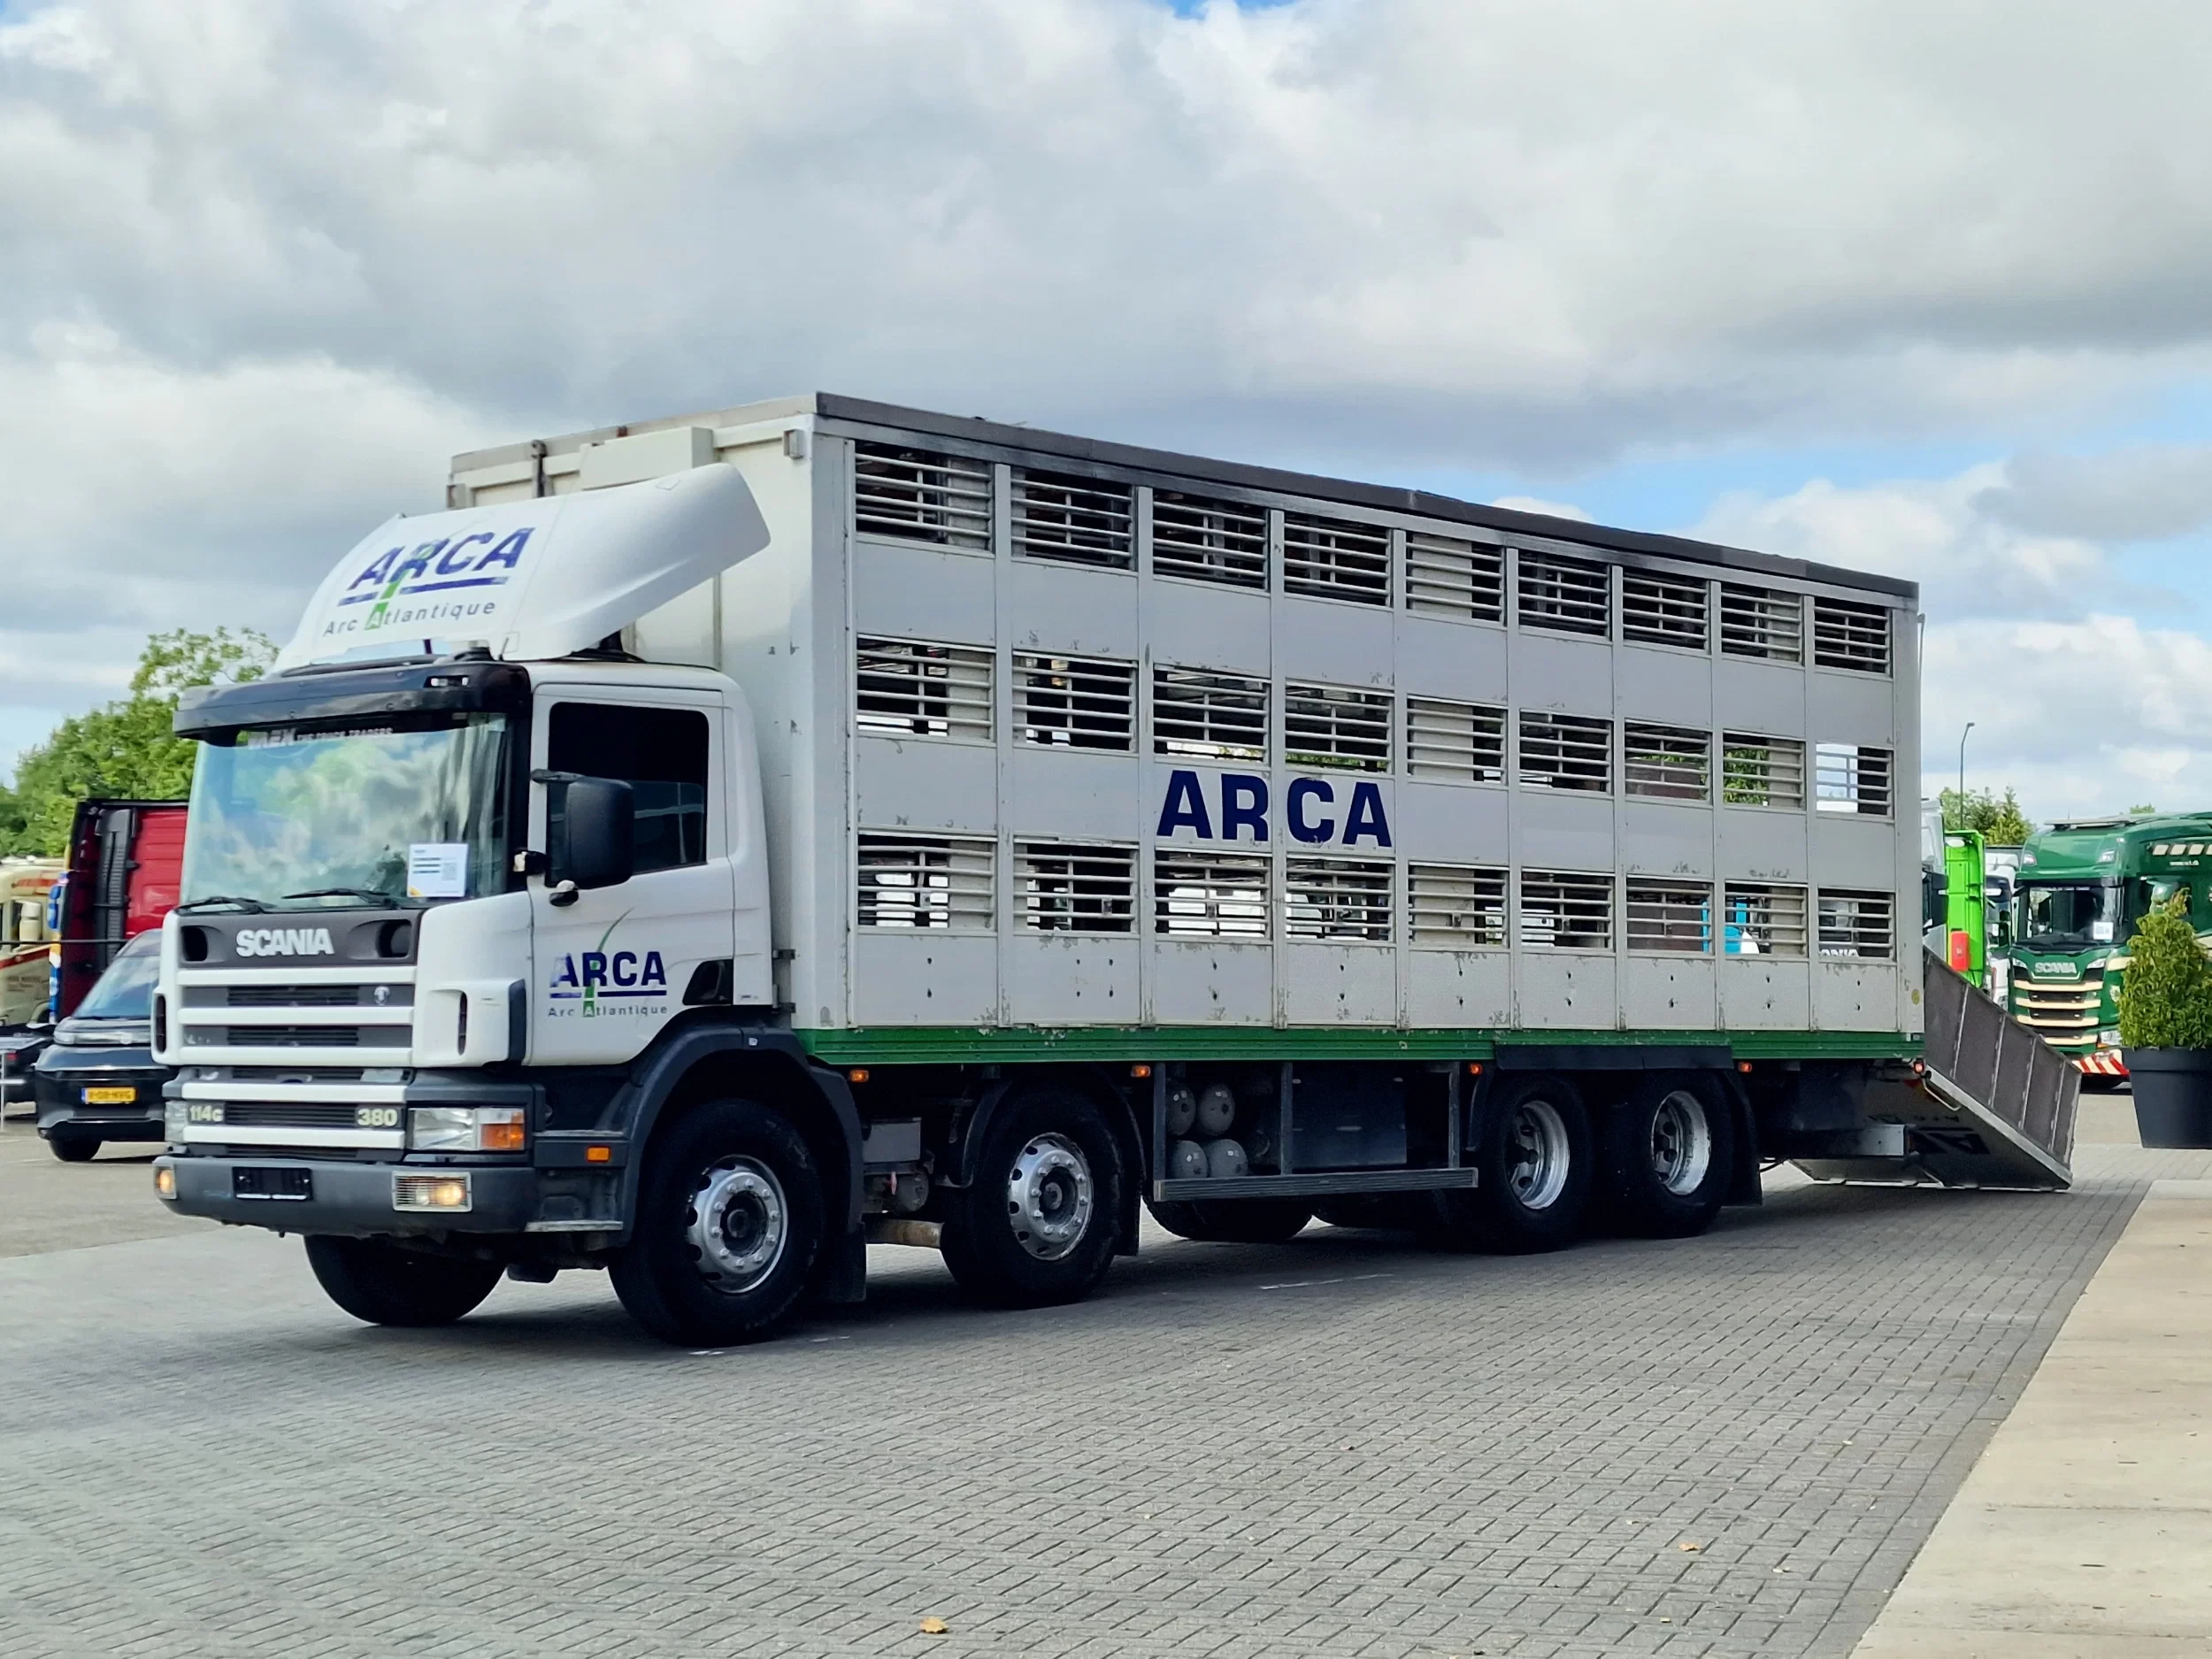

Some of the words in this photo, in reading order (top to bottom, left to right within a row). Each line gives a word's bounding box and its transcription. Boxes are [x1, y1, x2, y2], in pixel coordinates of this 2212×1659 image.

[346, 527, 535, 590] ARCA
[323, 618, 357, 636] Arc
[364, 602, 495, 631] Atlantique
[1156, 770, 1392, 847] ARCA
[235, 928, 334, 956] SCANIA
[549, 951, 666, 987] ARCA
[2035, 962, 2077, 973] SCANIA
[549, 1007, 575, 1017] Arc
[583, 1005, 667, 1017] Atlantique
[357, 1109, 397, 1126] 380
